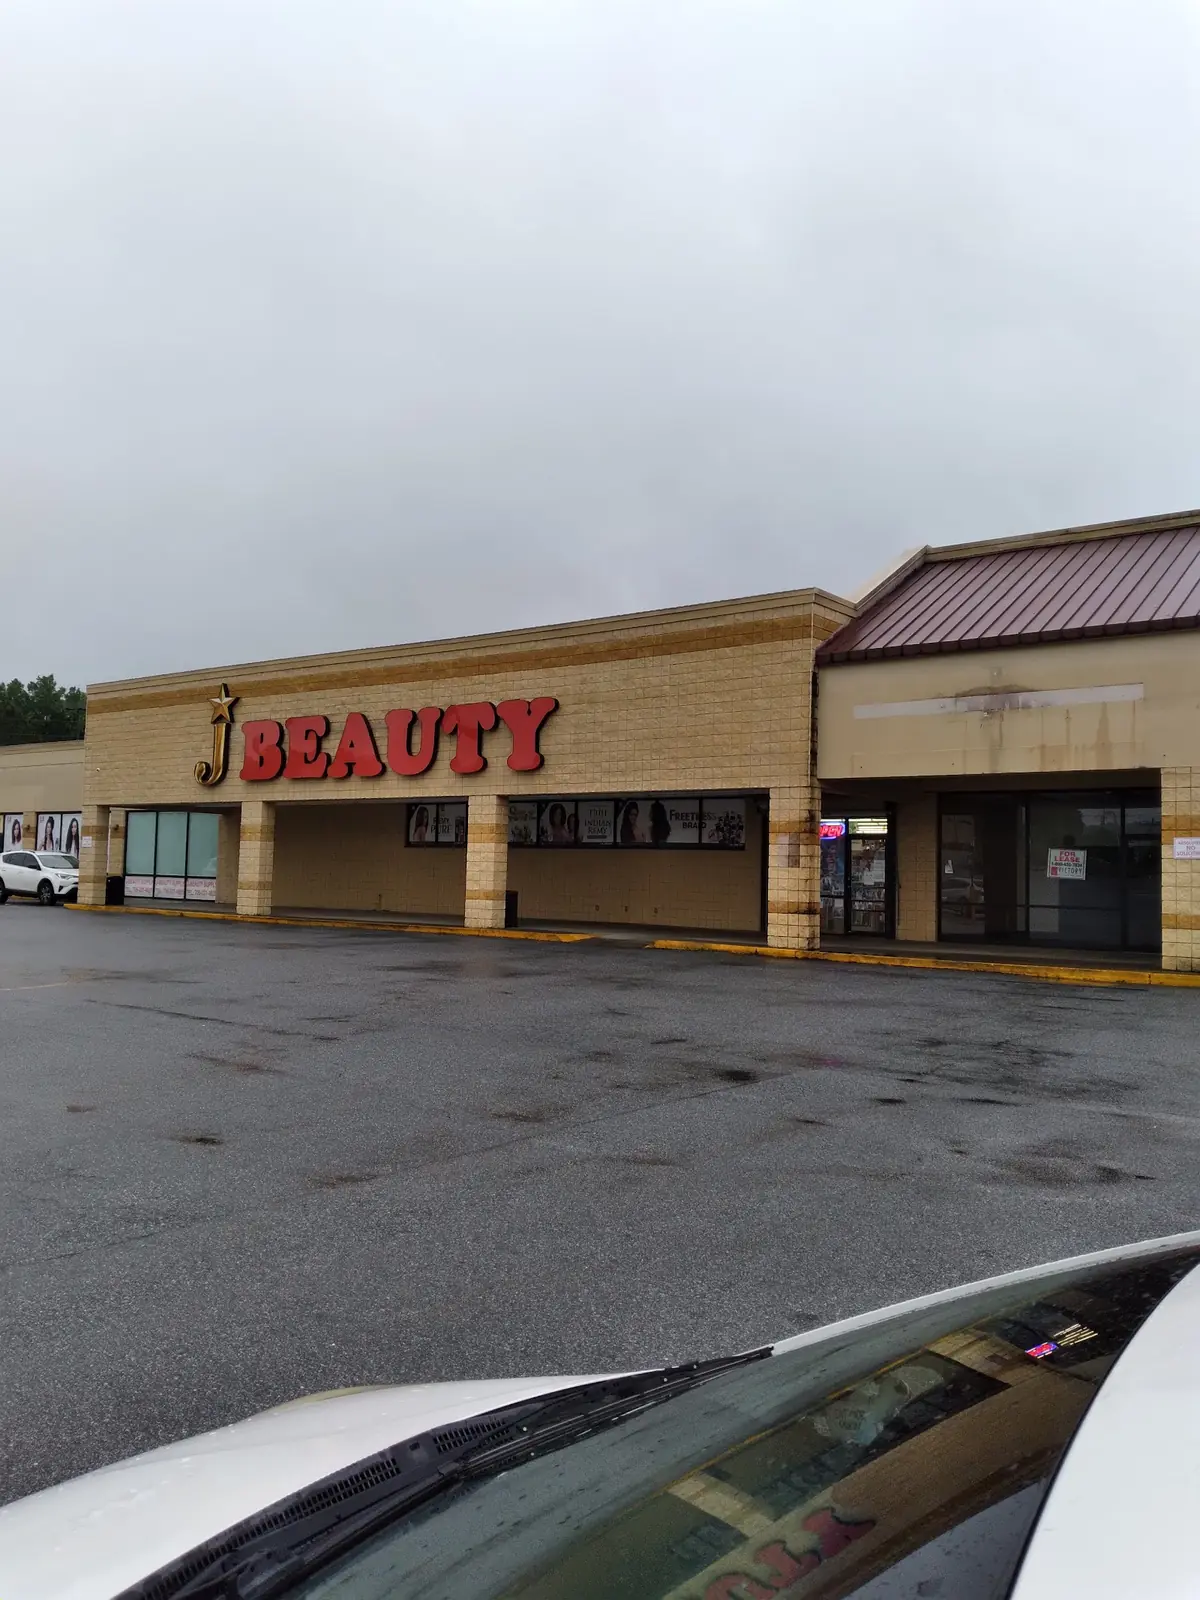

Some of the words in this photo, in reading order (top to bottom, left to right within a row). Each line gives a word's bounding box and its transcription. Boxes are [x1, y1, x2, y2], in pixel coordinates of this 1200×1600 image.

[239, 696, 559, 781] BEAUTY
[682, 821, 708, 829] BRAD
[820, 825, 842, 837] PEN
